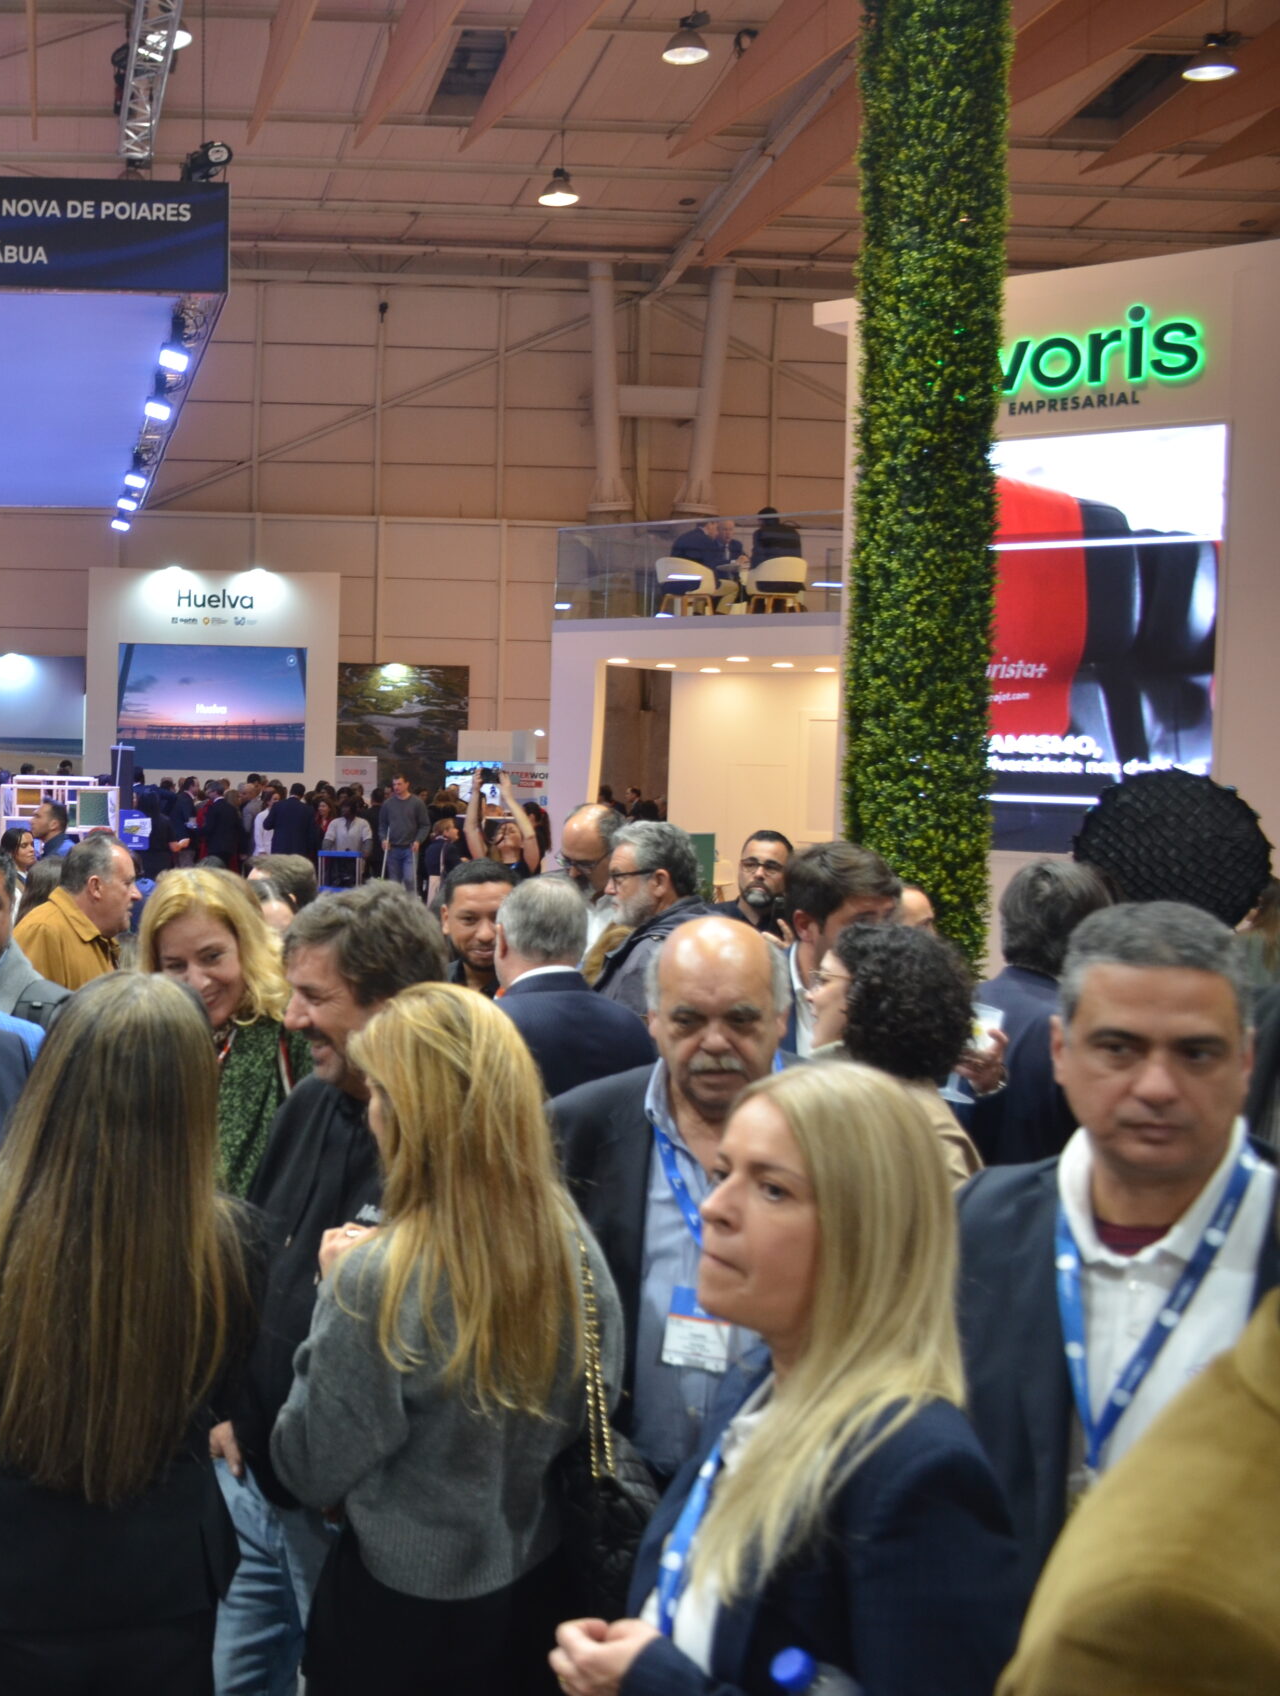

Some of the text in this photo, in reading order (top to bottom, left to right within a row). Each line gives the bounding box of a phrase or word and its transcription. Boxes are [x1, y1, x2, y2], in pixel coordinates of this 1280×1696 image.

[1, 198, 62, 218] NOVA
[66, 200, 95, 219] DE
[100, 201, 192, 222] POIARES
[1007, 390, 1140, 417] EMPRESARIAL
[177, 588, 254, 610] Huelva
